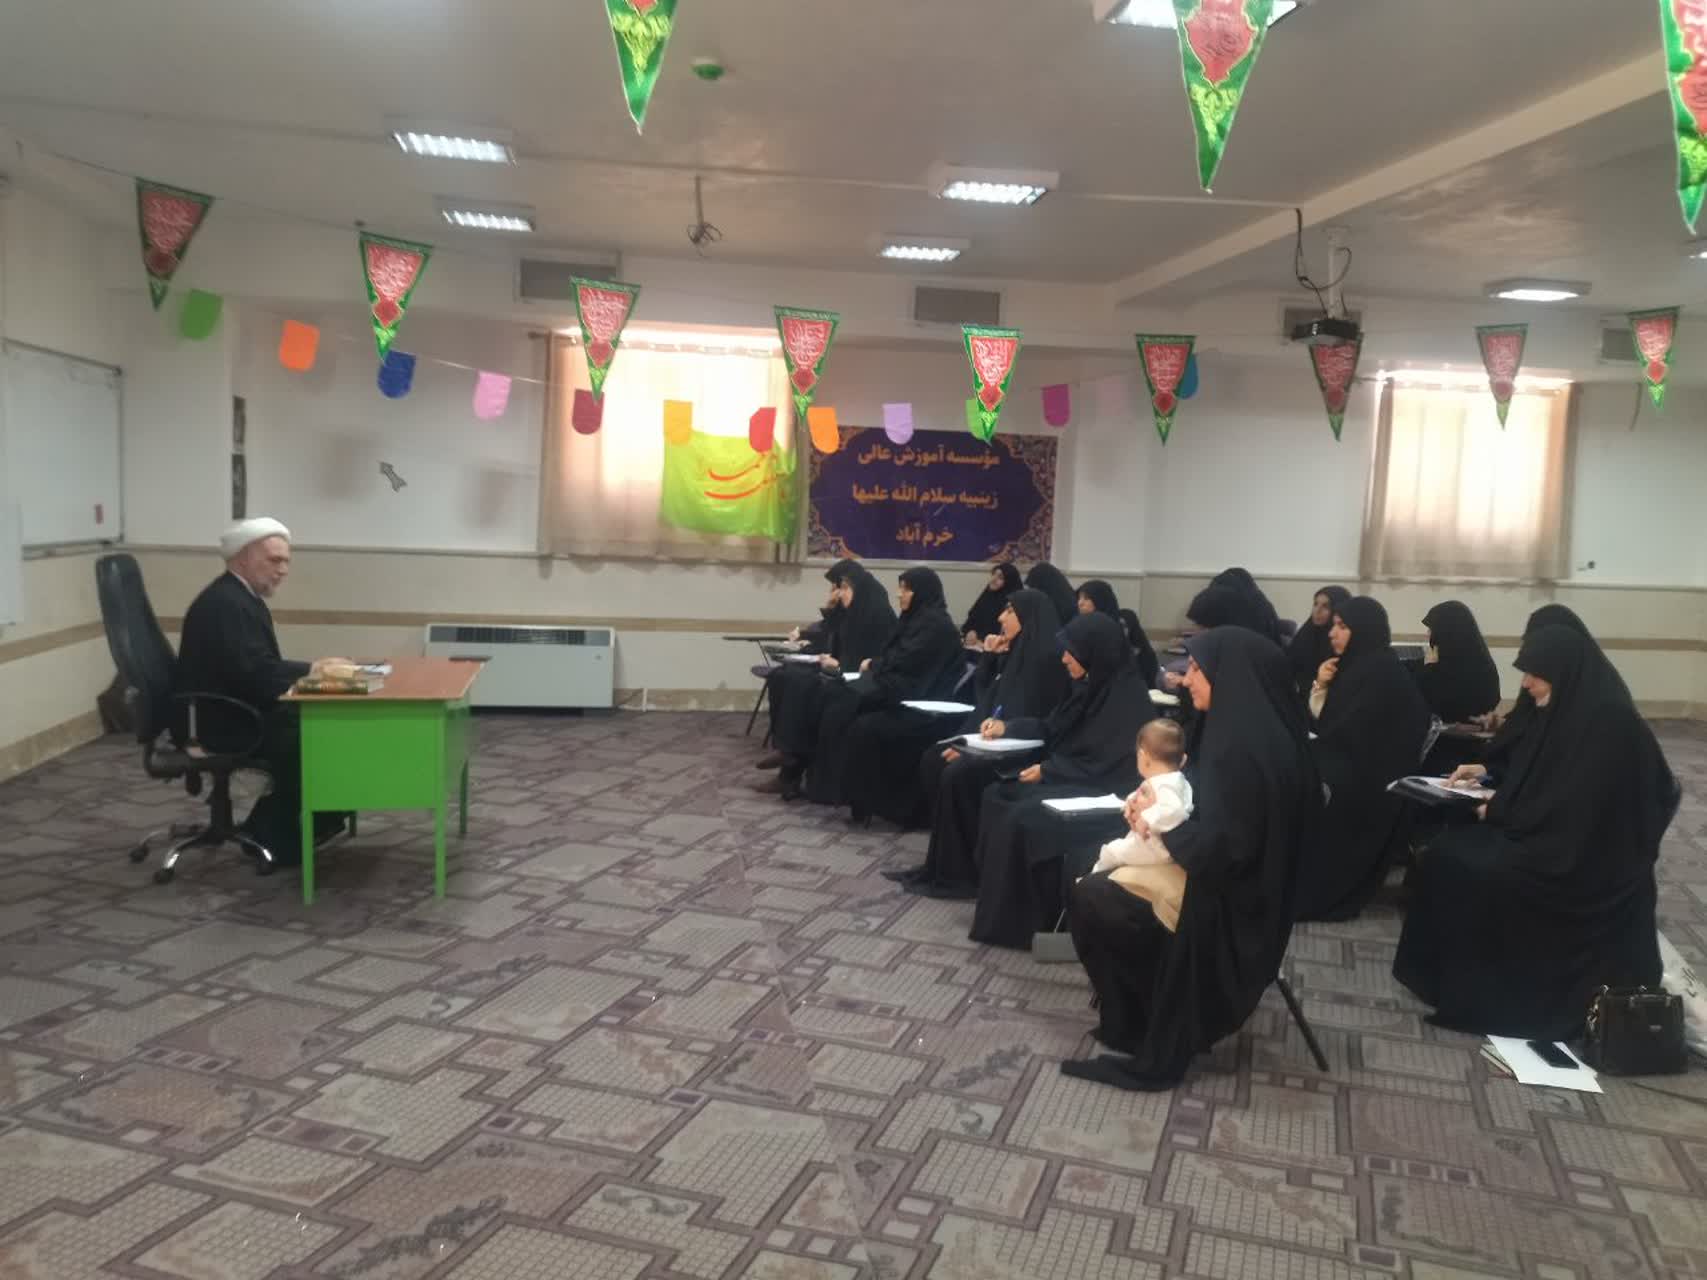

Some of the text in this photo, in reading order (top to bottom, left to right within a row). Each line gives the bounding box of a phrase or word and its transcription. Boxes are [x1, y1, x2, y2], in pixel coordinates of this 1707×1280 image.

[894, 444, 944, 467] آموزش
[946, 448, 1000, 470] مؤسسه
[852, 481, 889, 504] علیها
[891, 480, 918, 502] الله
[919, 487, 956, 508] سلام
[895, 522, 953, 547] خرم آباد
